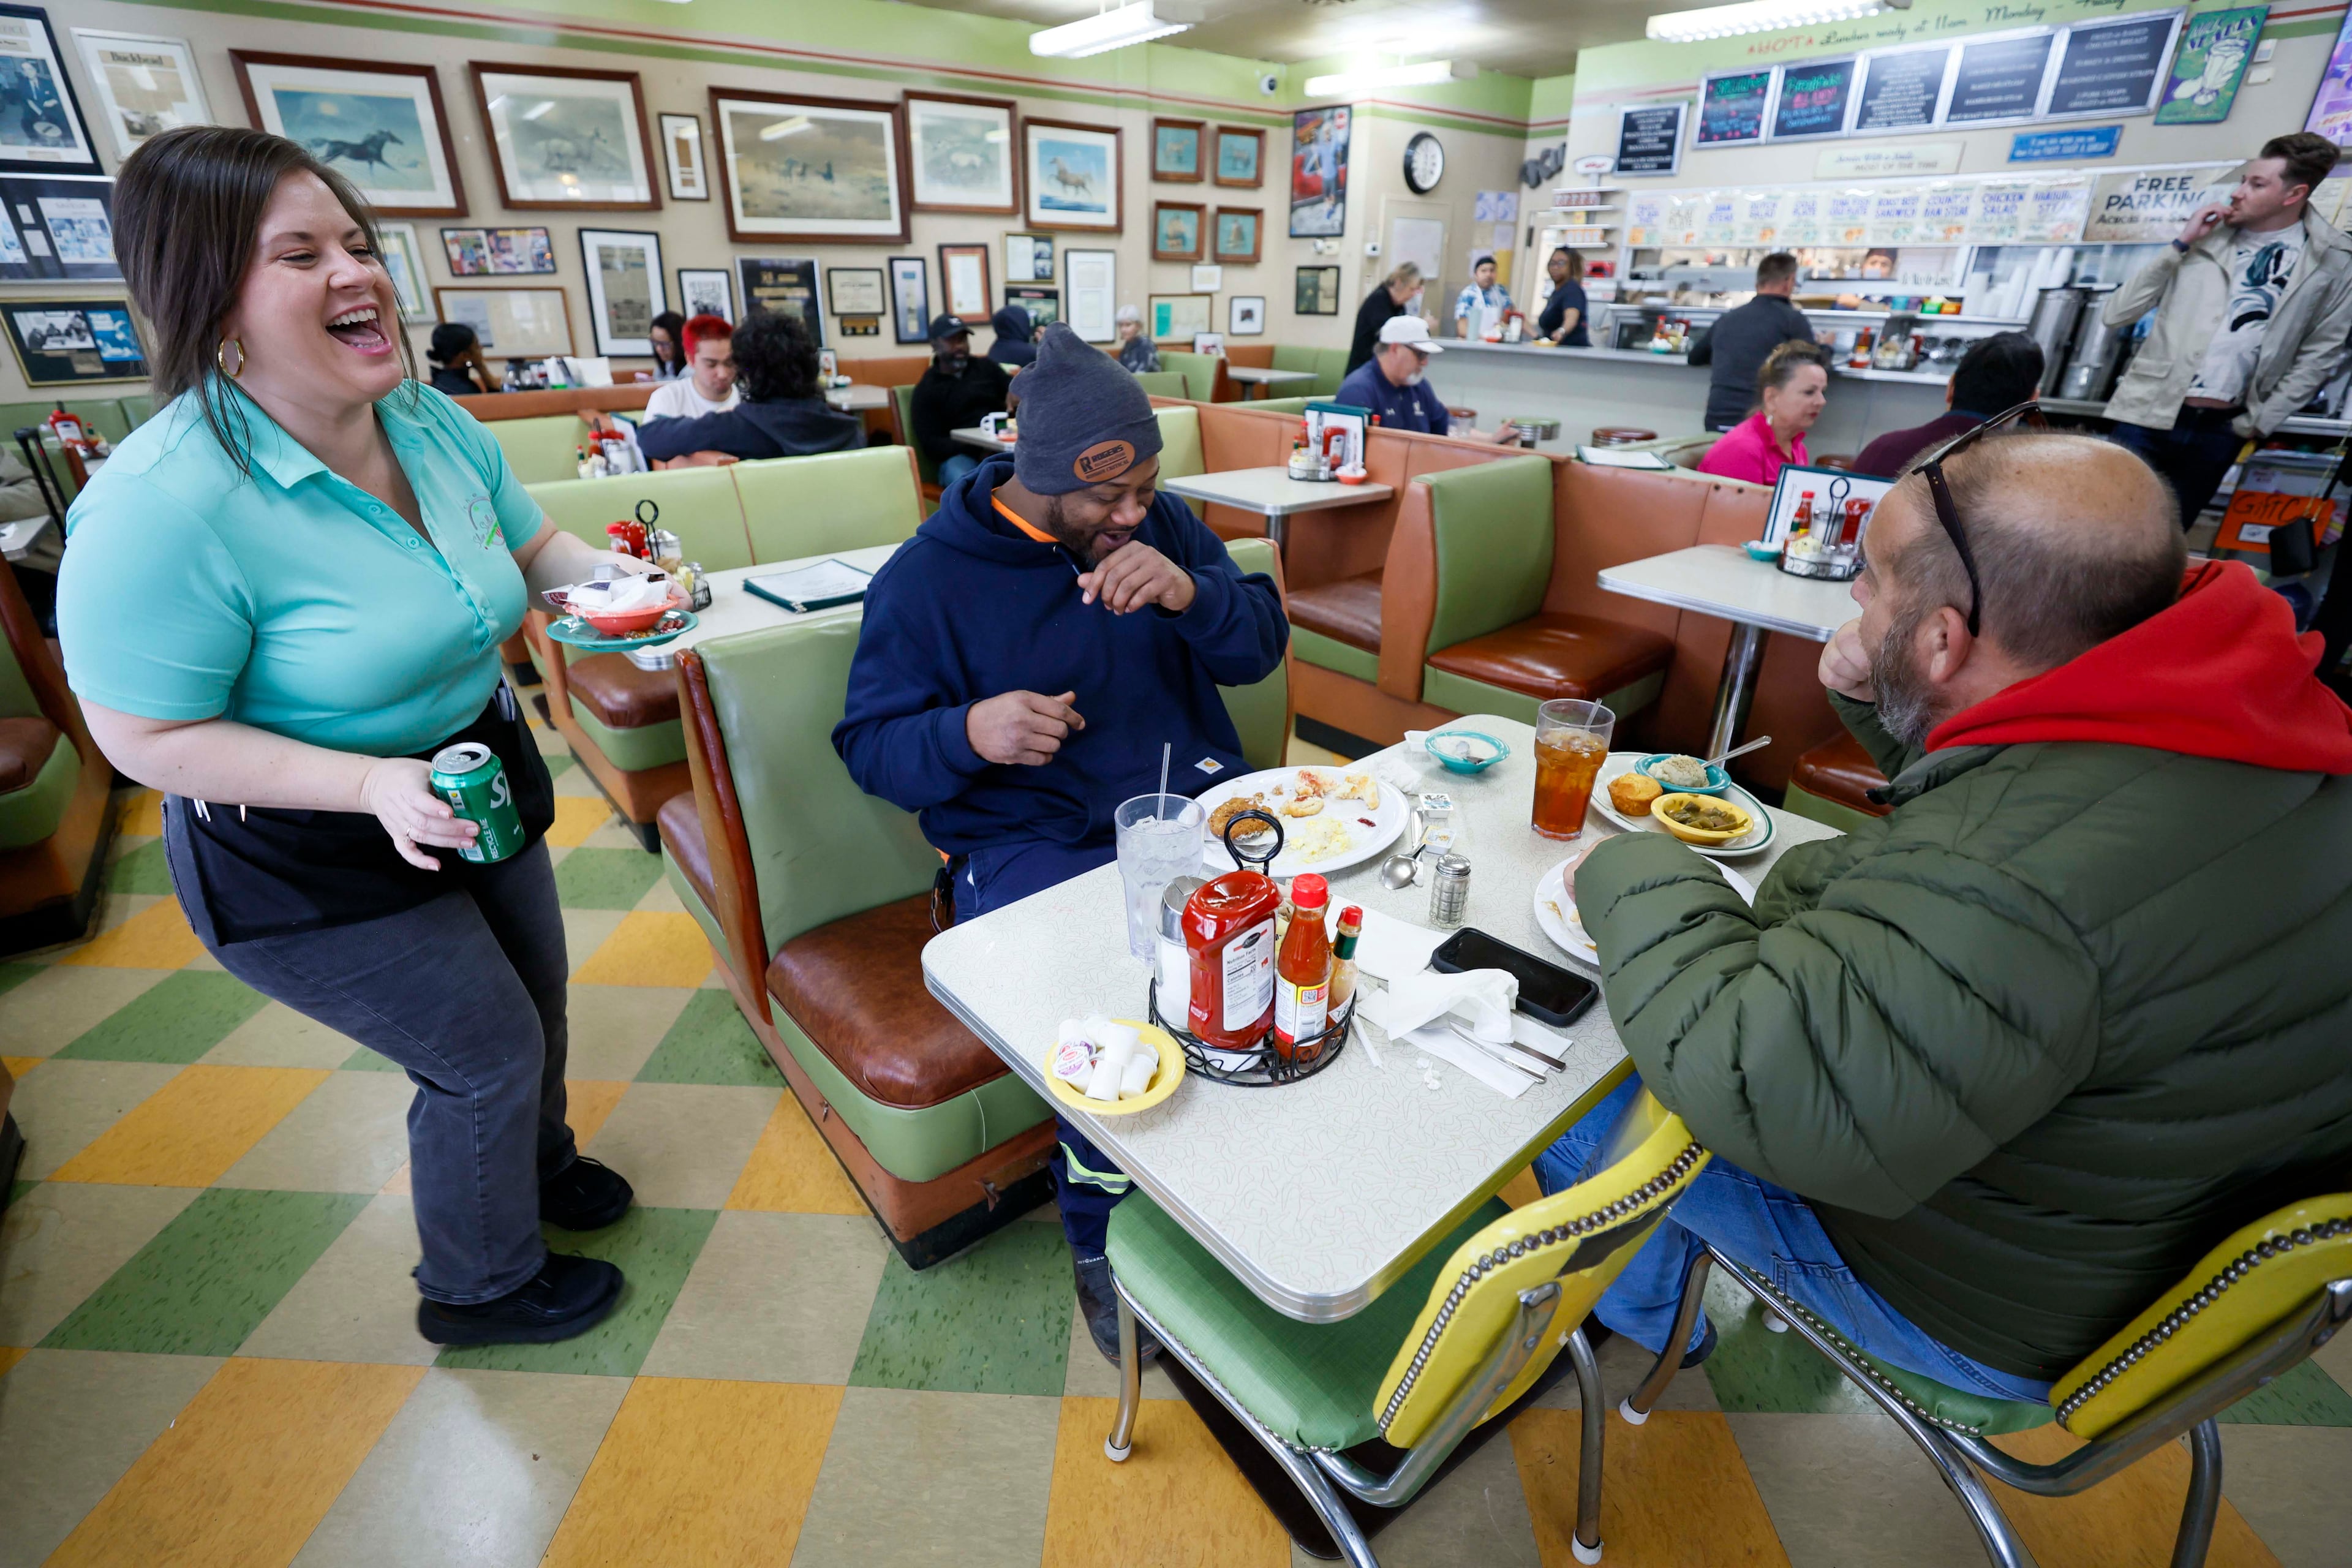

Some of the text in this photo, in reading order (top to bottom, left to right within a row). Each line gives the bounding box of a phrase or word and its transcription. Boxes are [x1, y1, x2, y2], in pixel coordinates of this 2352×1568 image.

[1819, 31, 1869, 46] Lunches
[1876, 26, 1906, 41] ready
[1914, 20, 1927, 33] at
[1986, 2, 2045, 22] Monday
[110, 51, 164, 65] Buckhead
[2135, 176, 2194, 192] FREE
[1982, 193, 2026, 203] CHICKEN
[1091, 444, 1124, 462] ROGERS
[2233, 492, 2282, 520] Gift
[479, 818, 500, 859] RECYCLE ME
[1227, 954, 1245, 965] Nutrition
[1227, 964, 1256, 983] Calories 20
